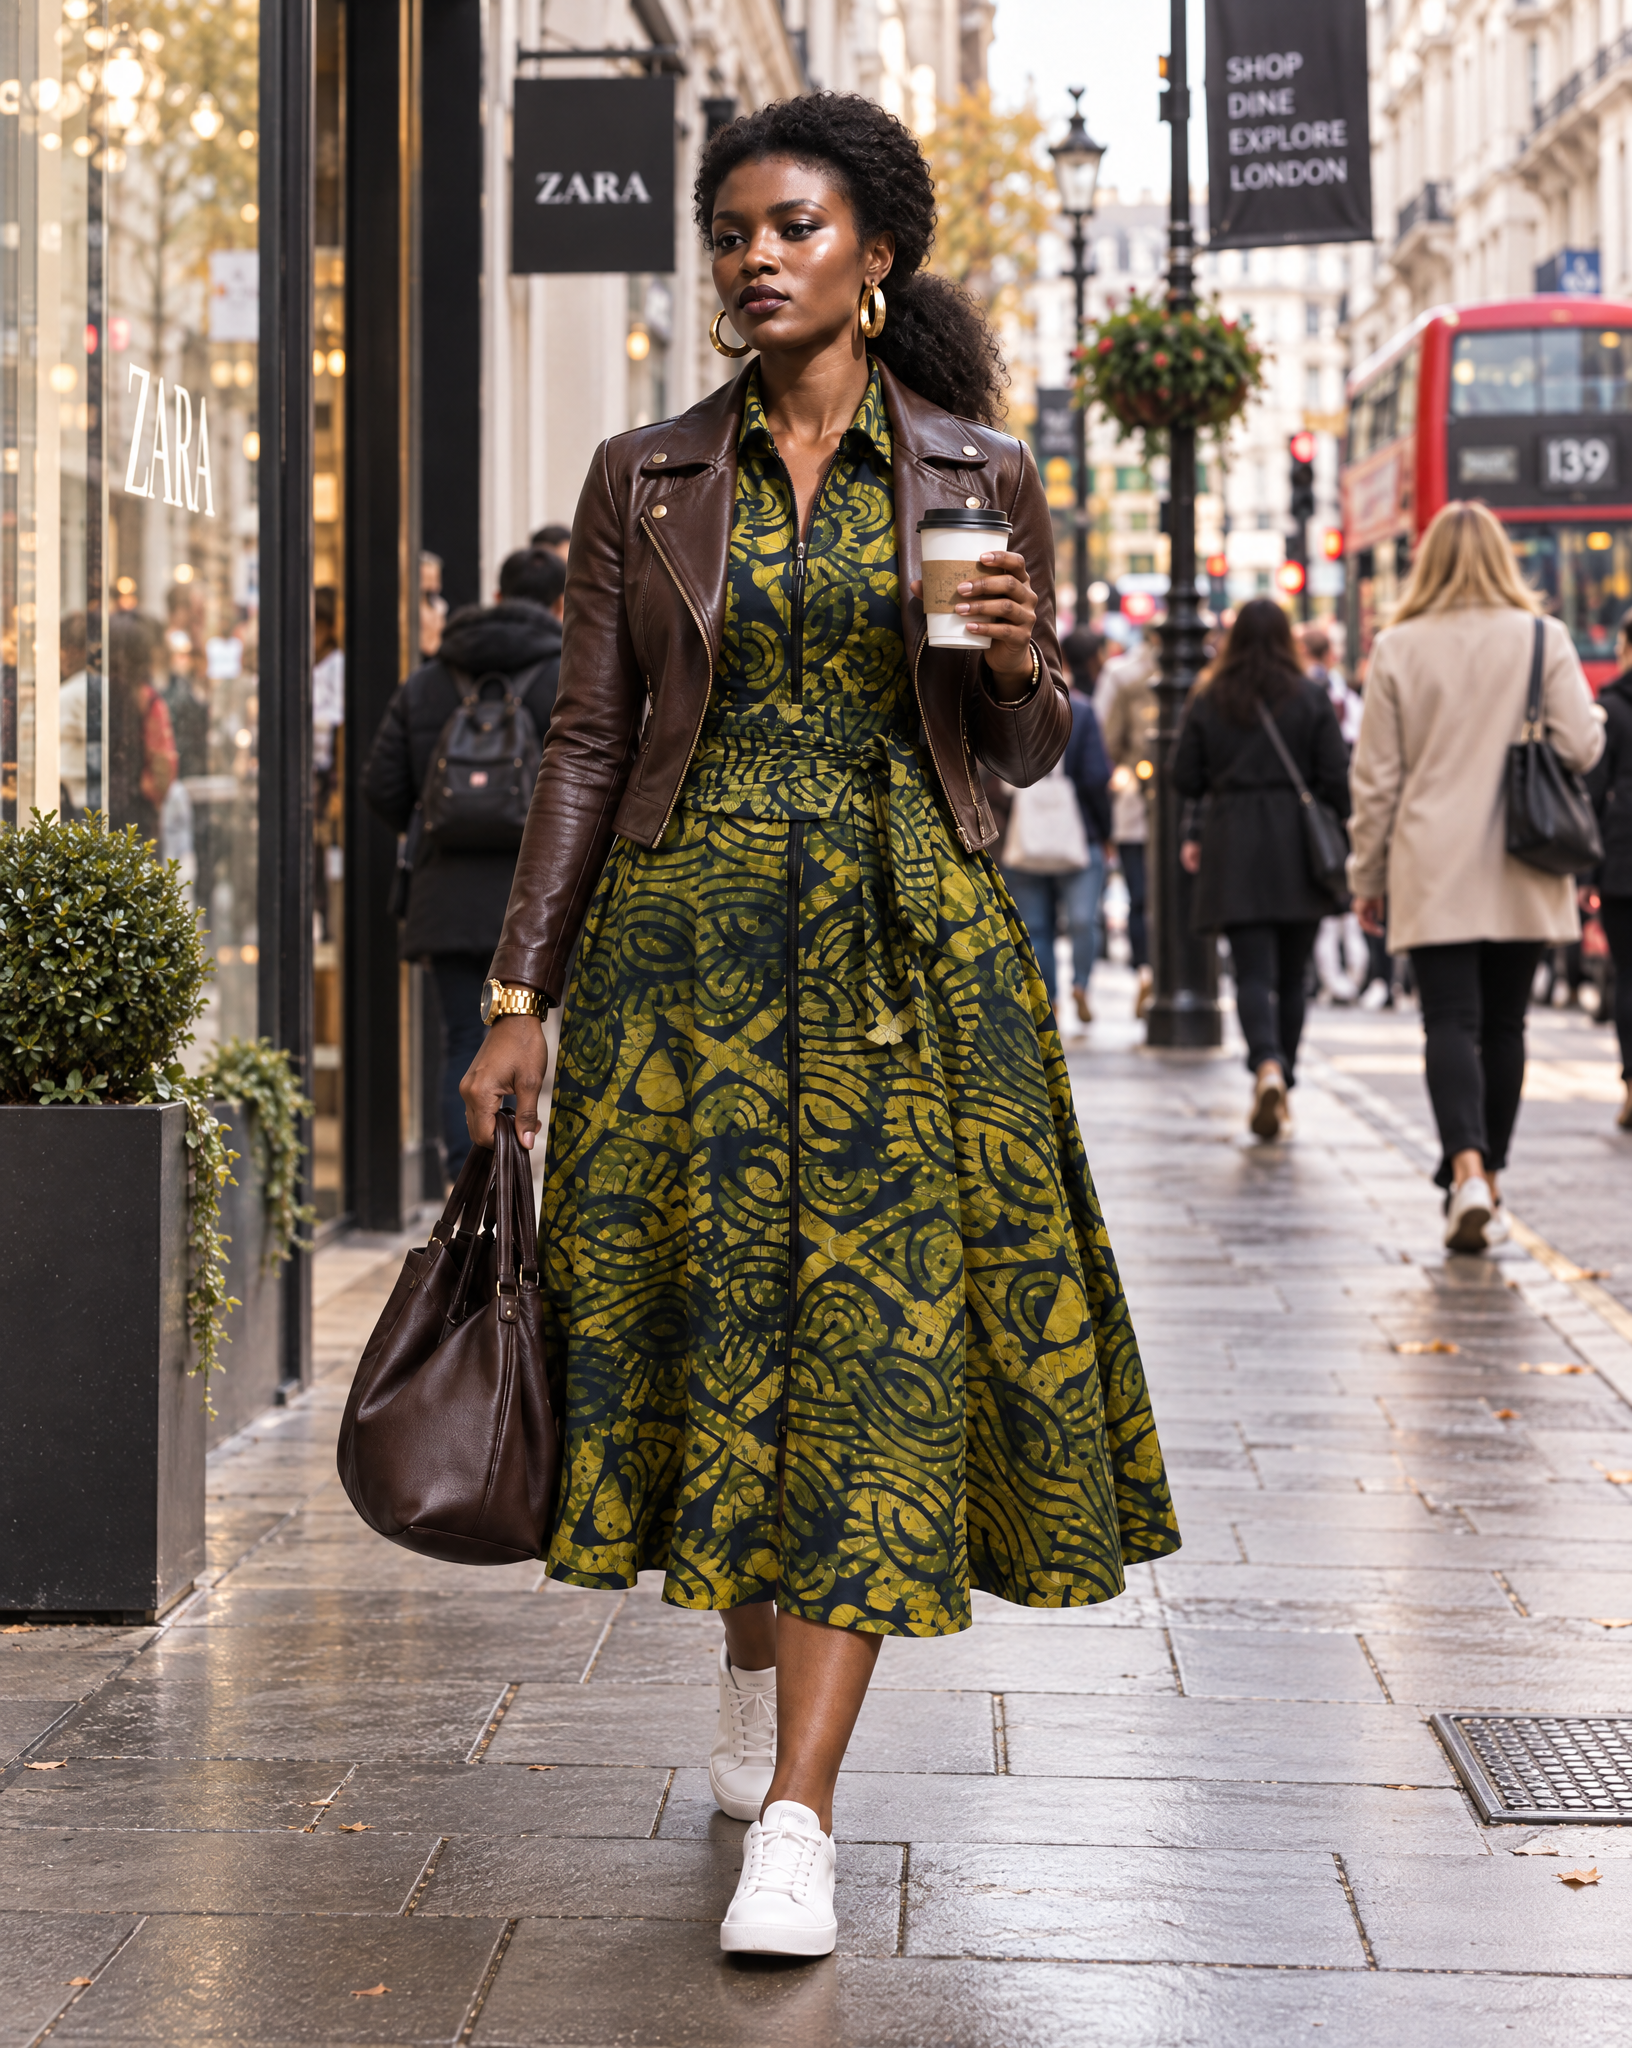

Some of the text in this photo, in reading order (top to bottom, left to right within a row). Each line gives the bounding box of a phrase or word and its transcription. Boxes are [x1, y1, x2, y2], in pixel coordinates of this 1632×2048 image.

[1226, 51, 1304, 84] SHOP
[1227, 87, 1296, 120] DINE
[1228, 119, 1348, 156] EXPLORE
[535, 171, 652, 205] ZARA
[1230, 156, 1348, 191] LONDON
[124, 362, 216, 518] ZARA
[1548, 438, 1610, 484] 139
